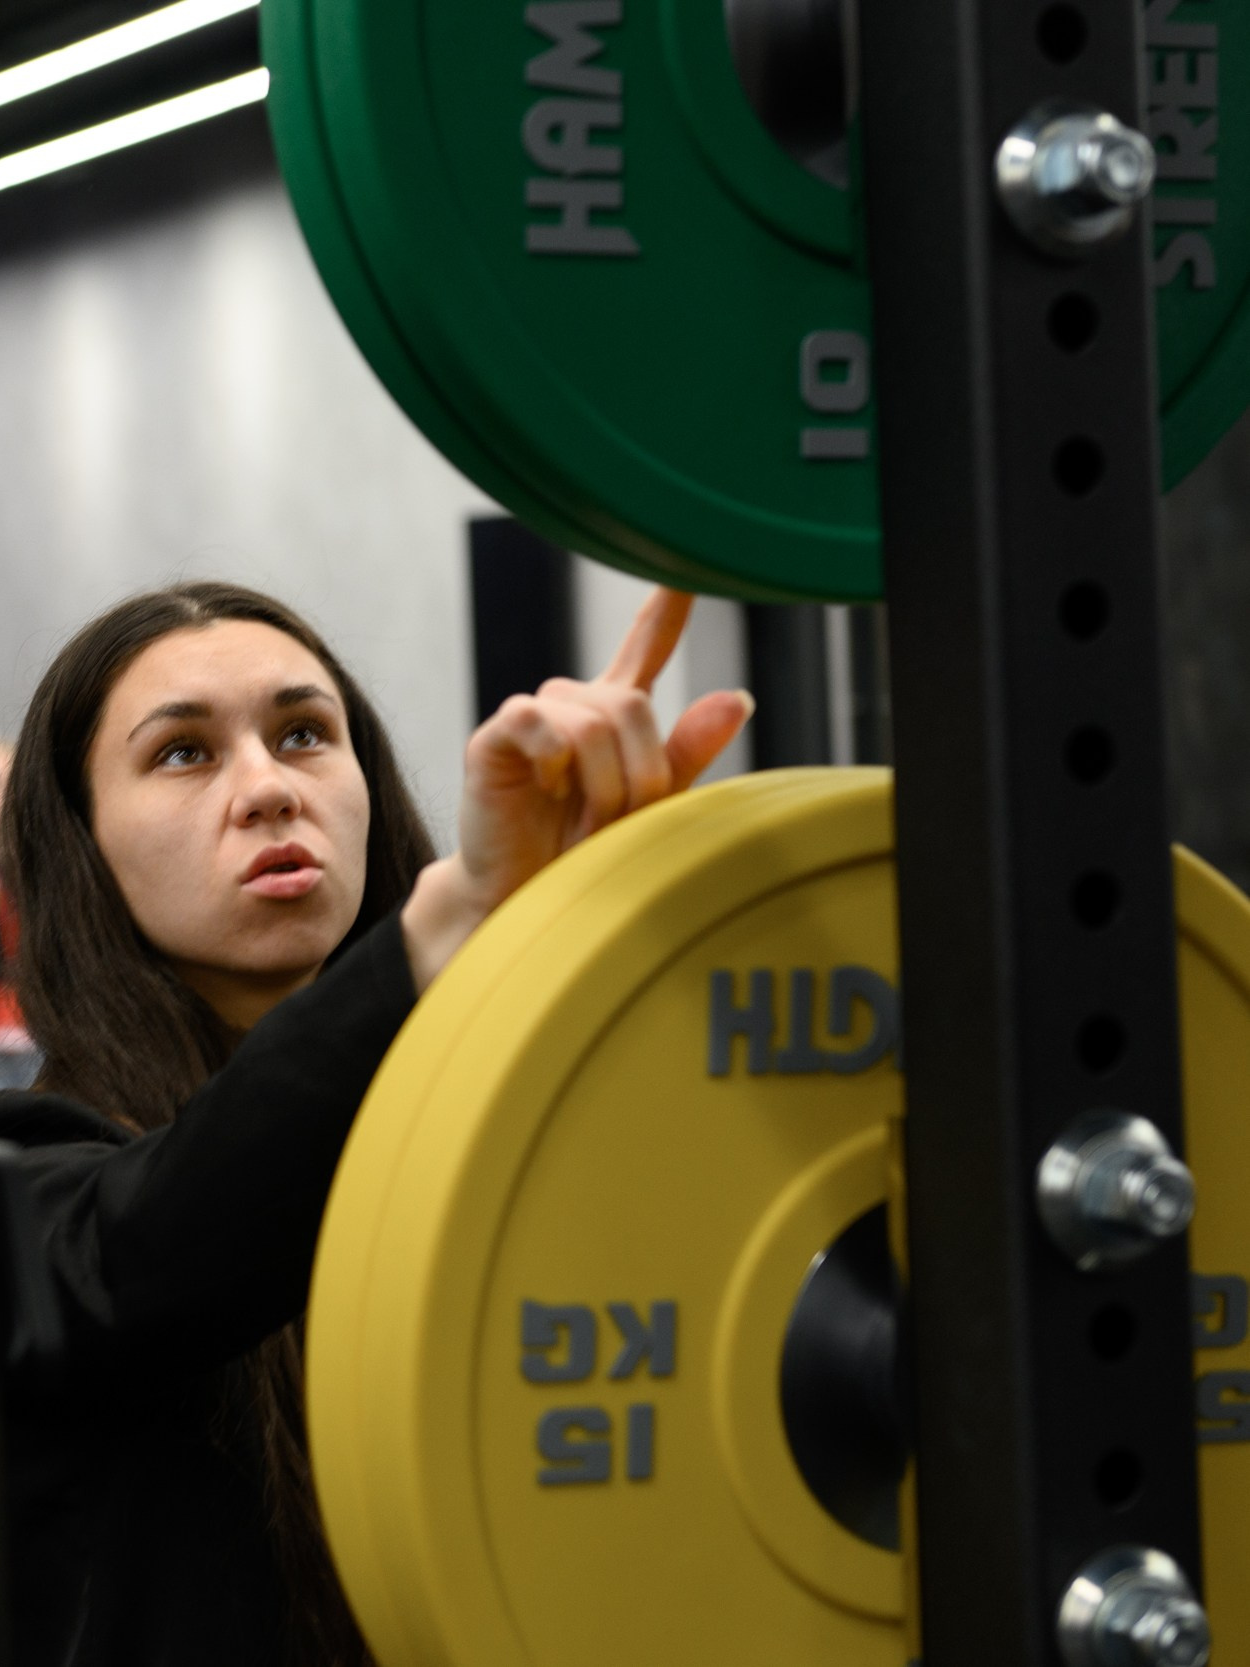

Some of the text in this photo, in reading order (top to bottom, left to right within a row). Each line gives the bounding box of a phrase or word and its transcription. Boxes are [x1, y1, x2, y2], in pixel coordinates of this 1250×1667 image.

[522, 0, 641, 257] HAM
[800, 328, 869, 459] 10
[706, 964, 904, 1075] GTH
[521, 1299, 676, 1383] KG
[537, 1404, 654, 1486] 15
